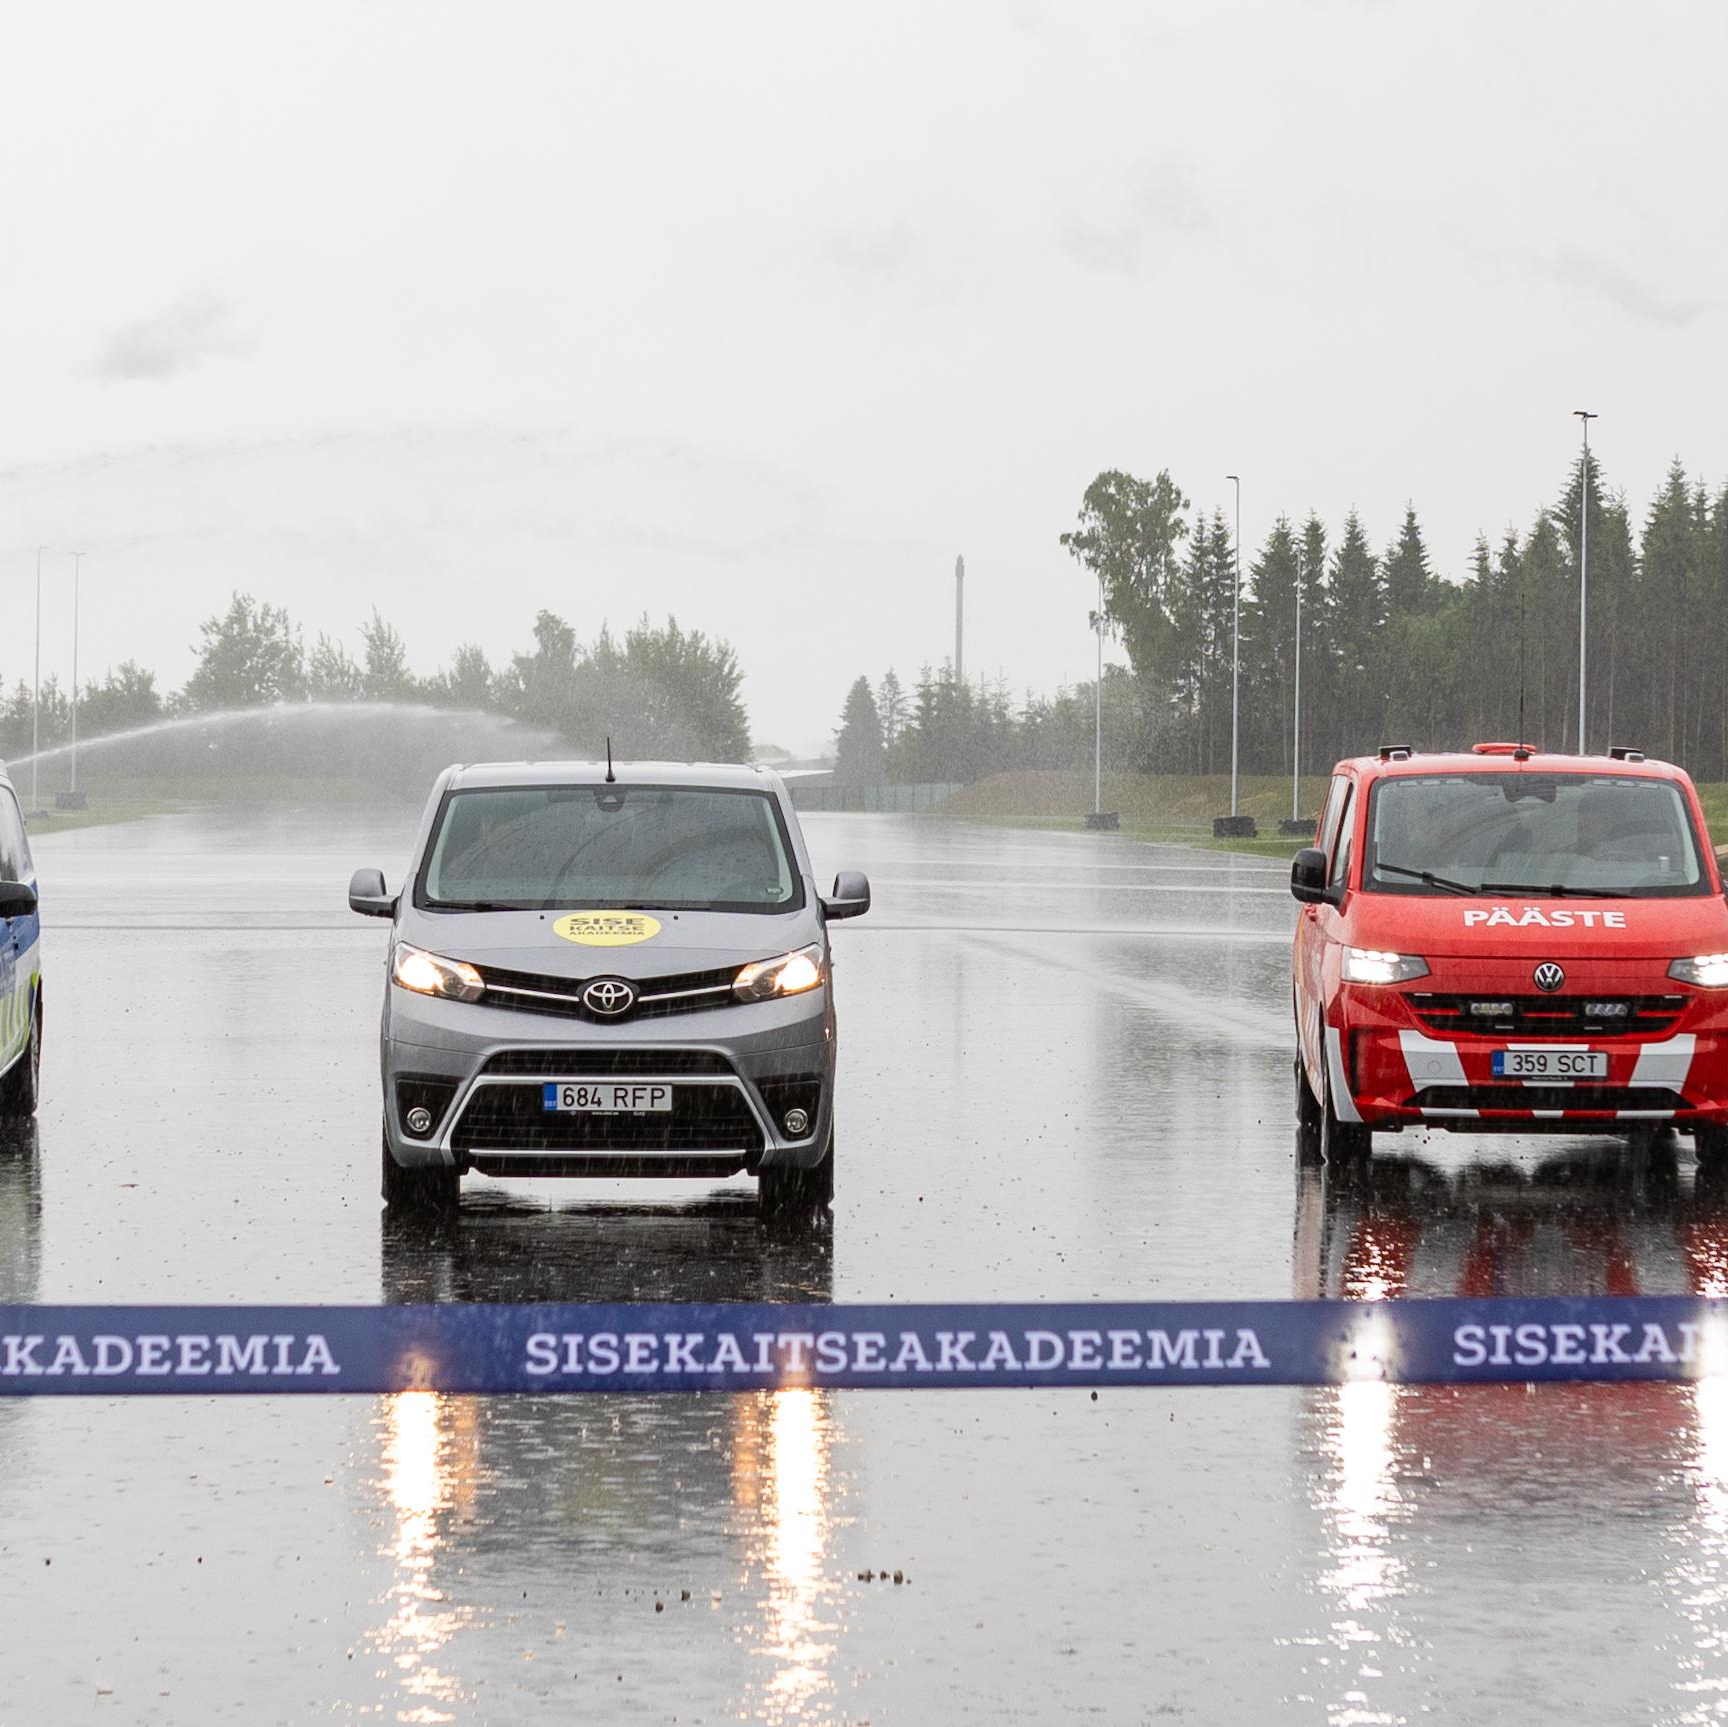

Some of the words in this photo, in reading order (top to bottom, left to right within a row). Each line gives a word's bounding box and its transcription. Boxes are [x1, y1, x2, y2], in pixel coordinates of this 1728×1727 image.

[570, 918, 645, 926] SISE
[1463, 906, 1627, 928] PÄÄSTE
[1512, 1054, 1548, 1073] 359
[1558, 1055, 1598, 1074] SCT
[563, 1086, 603, 1108] 684
[613, 1087, 666, 1108] RFP
[524, 1328, 1271, 1375] SISEKAITSEAKADEEMIA
